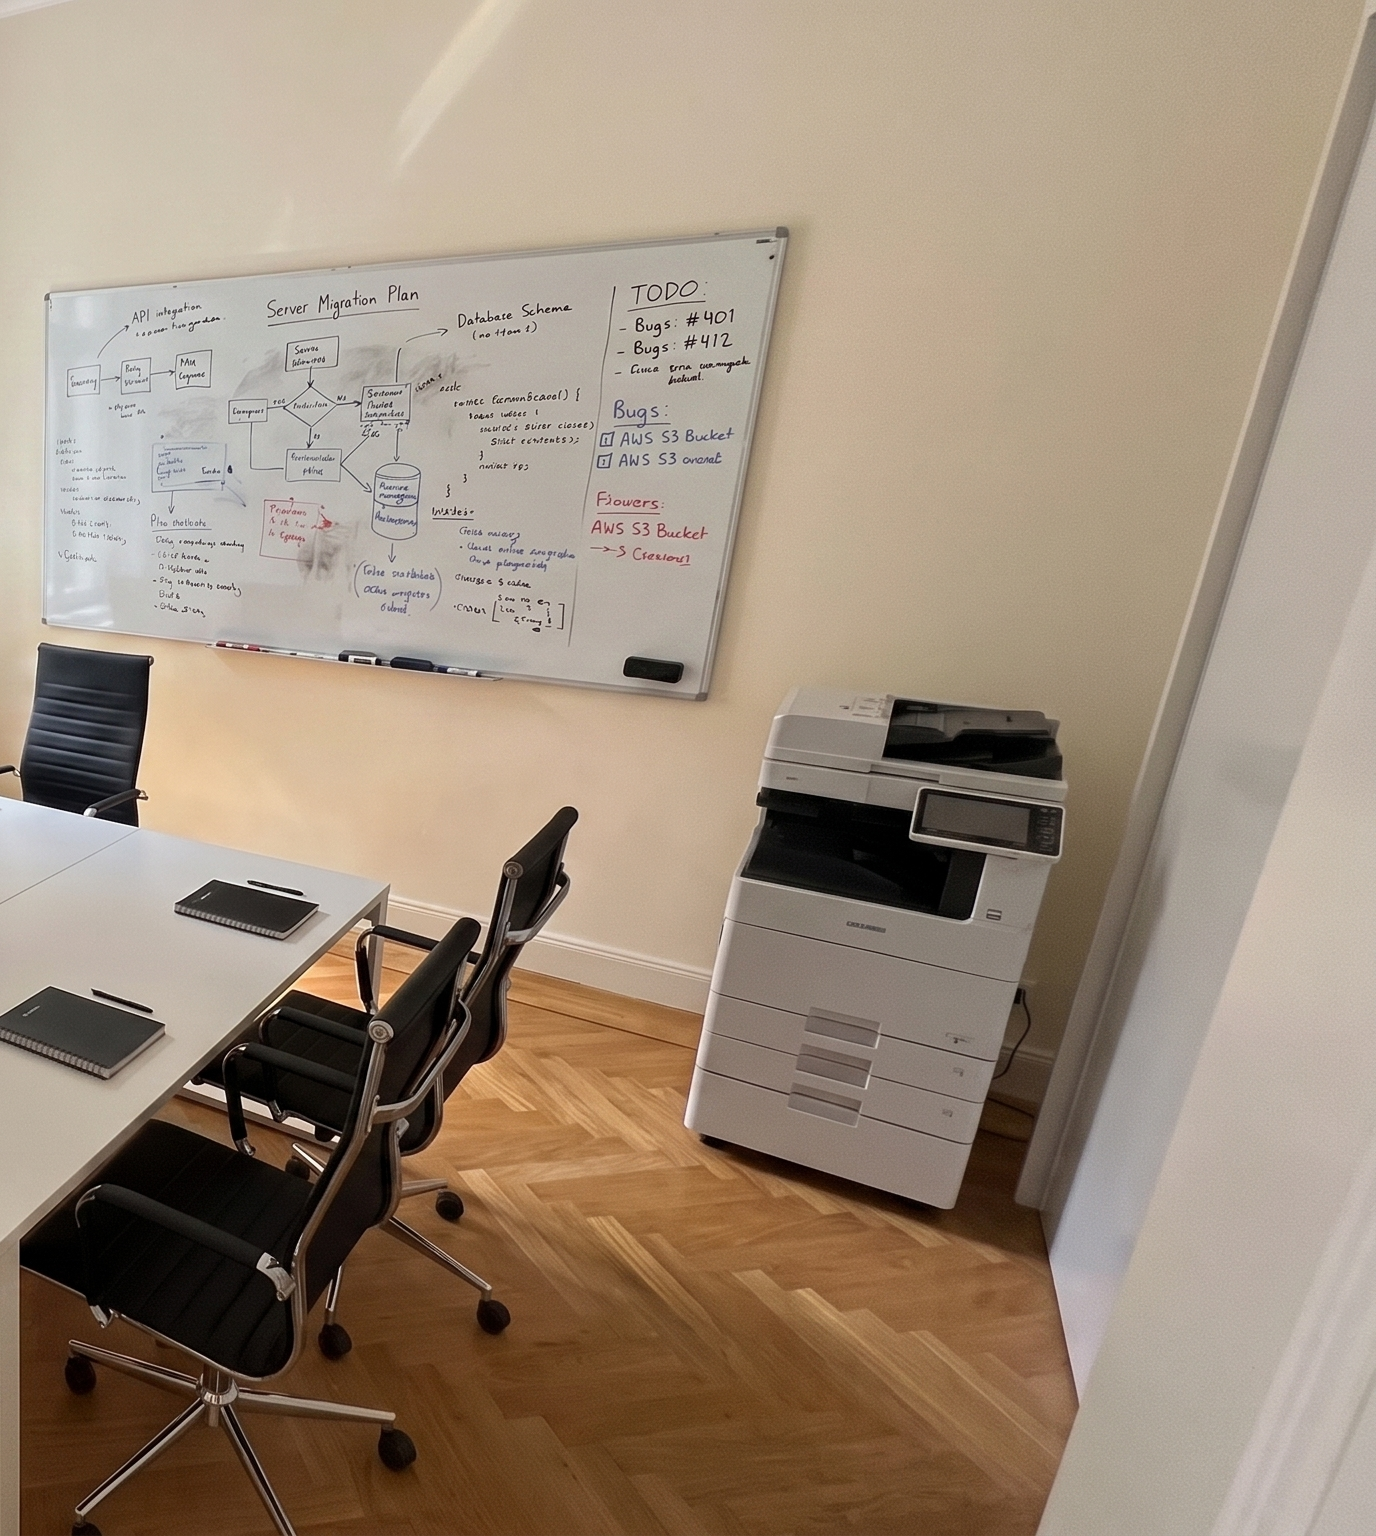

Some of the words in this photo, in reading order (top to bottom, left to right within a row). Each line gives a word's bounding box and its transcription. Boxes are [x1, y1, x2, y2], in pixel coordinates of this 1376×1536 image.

[267, 299, 308, 318] Server
[318, 290, 377, 319] Migration
[388, 285, 419, 303] Plan
[631, 280, 708, 304] TODO:
[132, 309, 150, 324] API
[635, 317, 678, 337] Bugs:
[686, 309, 735, 326] #401
[634, 340, 676, 359] Bugs:
[684, 332, 733, 350] #412
[613, 399, 669, 428] Bugs:
[620, 431, 653, 447] AWS
[662, 430, 679, 443] S3
[685, 427, 735, 442] Bucket
[618, 453, 651, 467] AWS
[658, 452, 677, 465] S3
[590, 520, 624, 534] AWS
[632, 522, 650, 536] S3
[657, 522, 709, 540] Bucket
